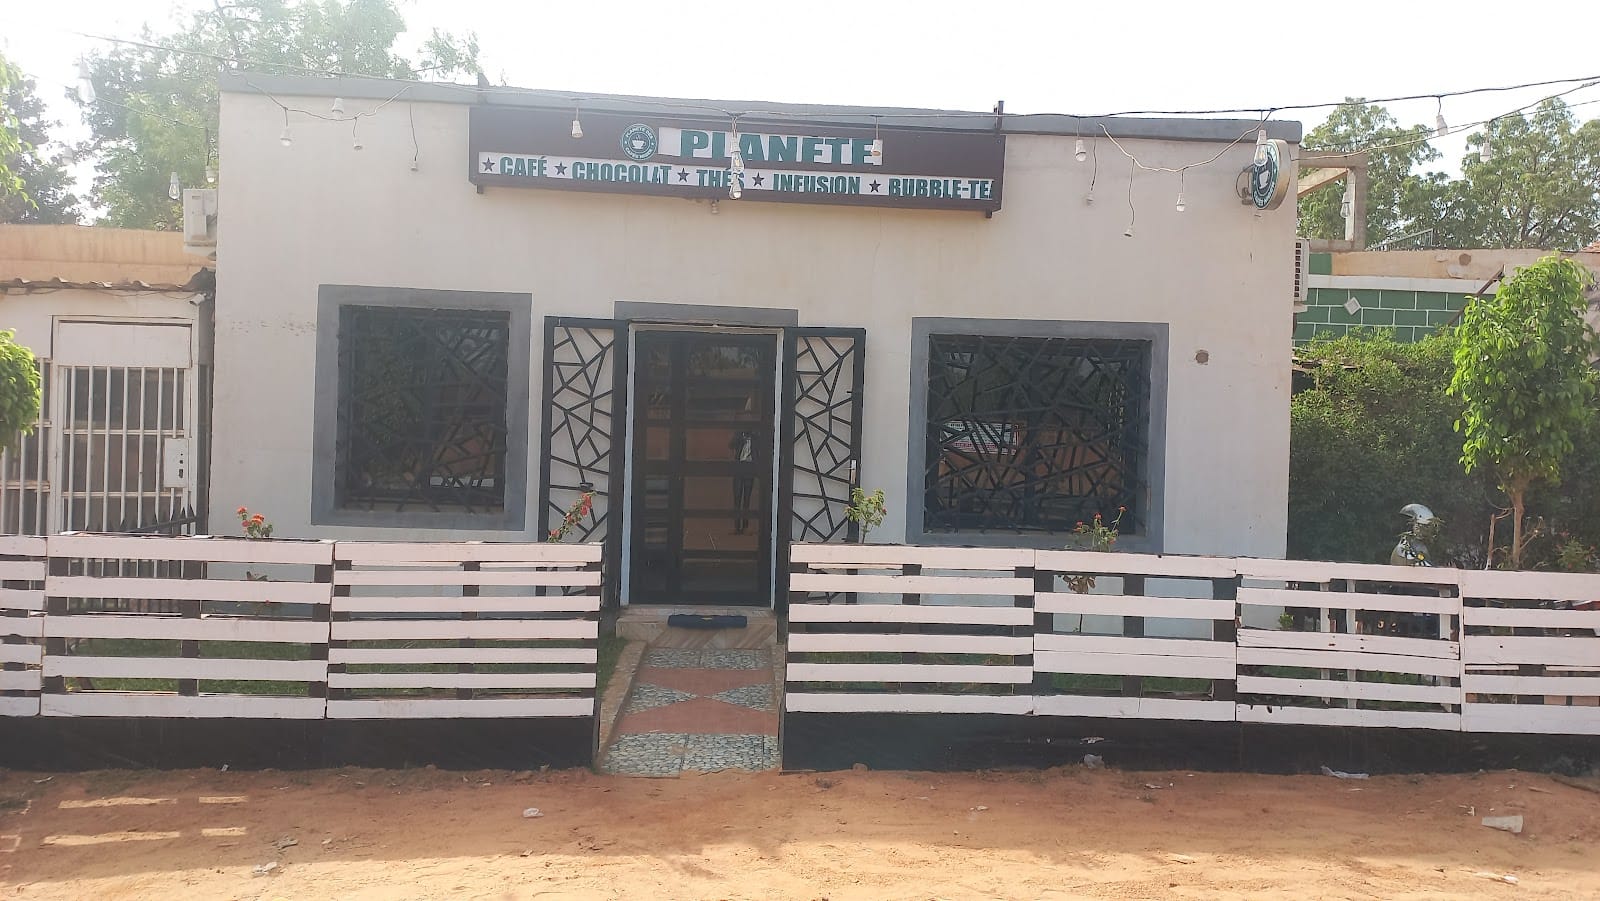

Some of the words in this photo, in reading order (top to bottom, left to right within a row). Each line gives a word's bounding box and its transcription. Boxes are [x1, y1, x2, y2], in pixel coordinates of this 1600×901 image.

[500, 156, 547, 177] CAFÉ
[572, 161, 672, 185] CHOCOLAT
[773, 173, 861, 195] INFUSION
